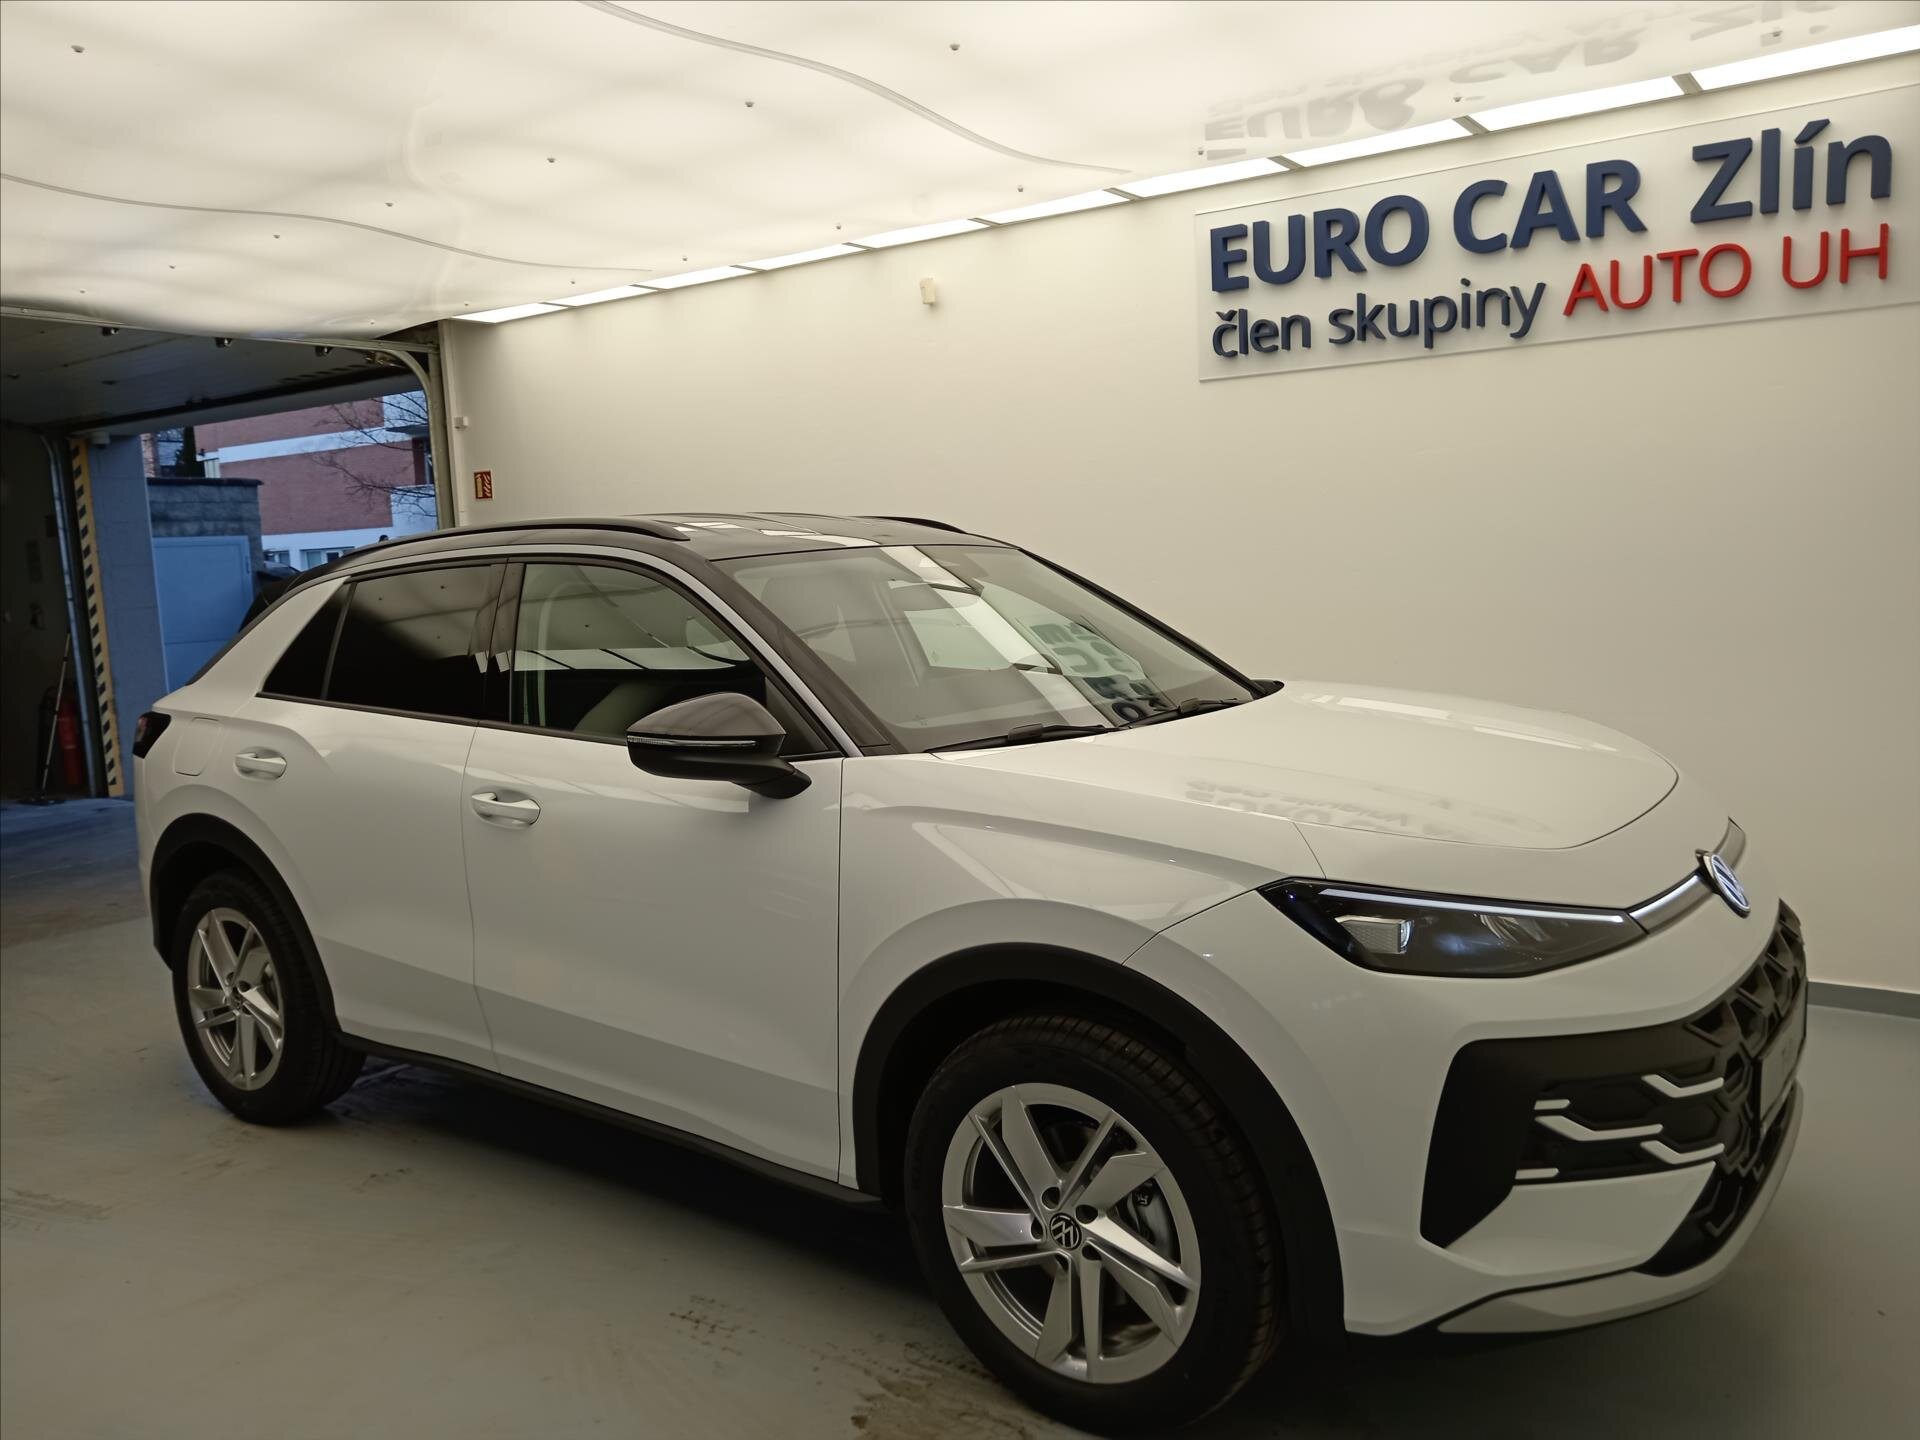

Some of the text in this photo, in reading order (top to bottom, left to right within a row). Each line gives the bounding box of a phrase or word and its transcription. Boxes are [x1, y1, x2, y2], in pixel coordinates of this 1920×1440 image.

[1210, 118, 1893, 294] EURO CAR Zlín
[1212, 223, 1889, 359] člen skupiny AUTO UH
